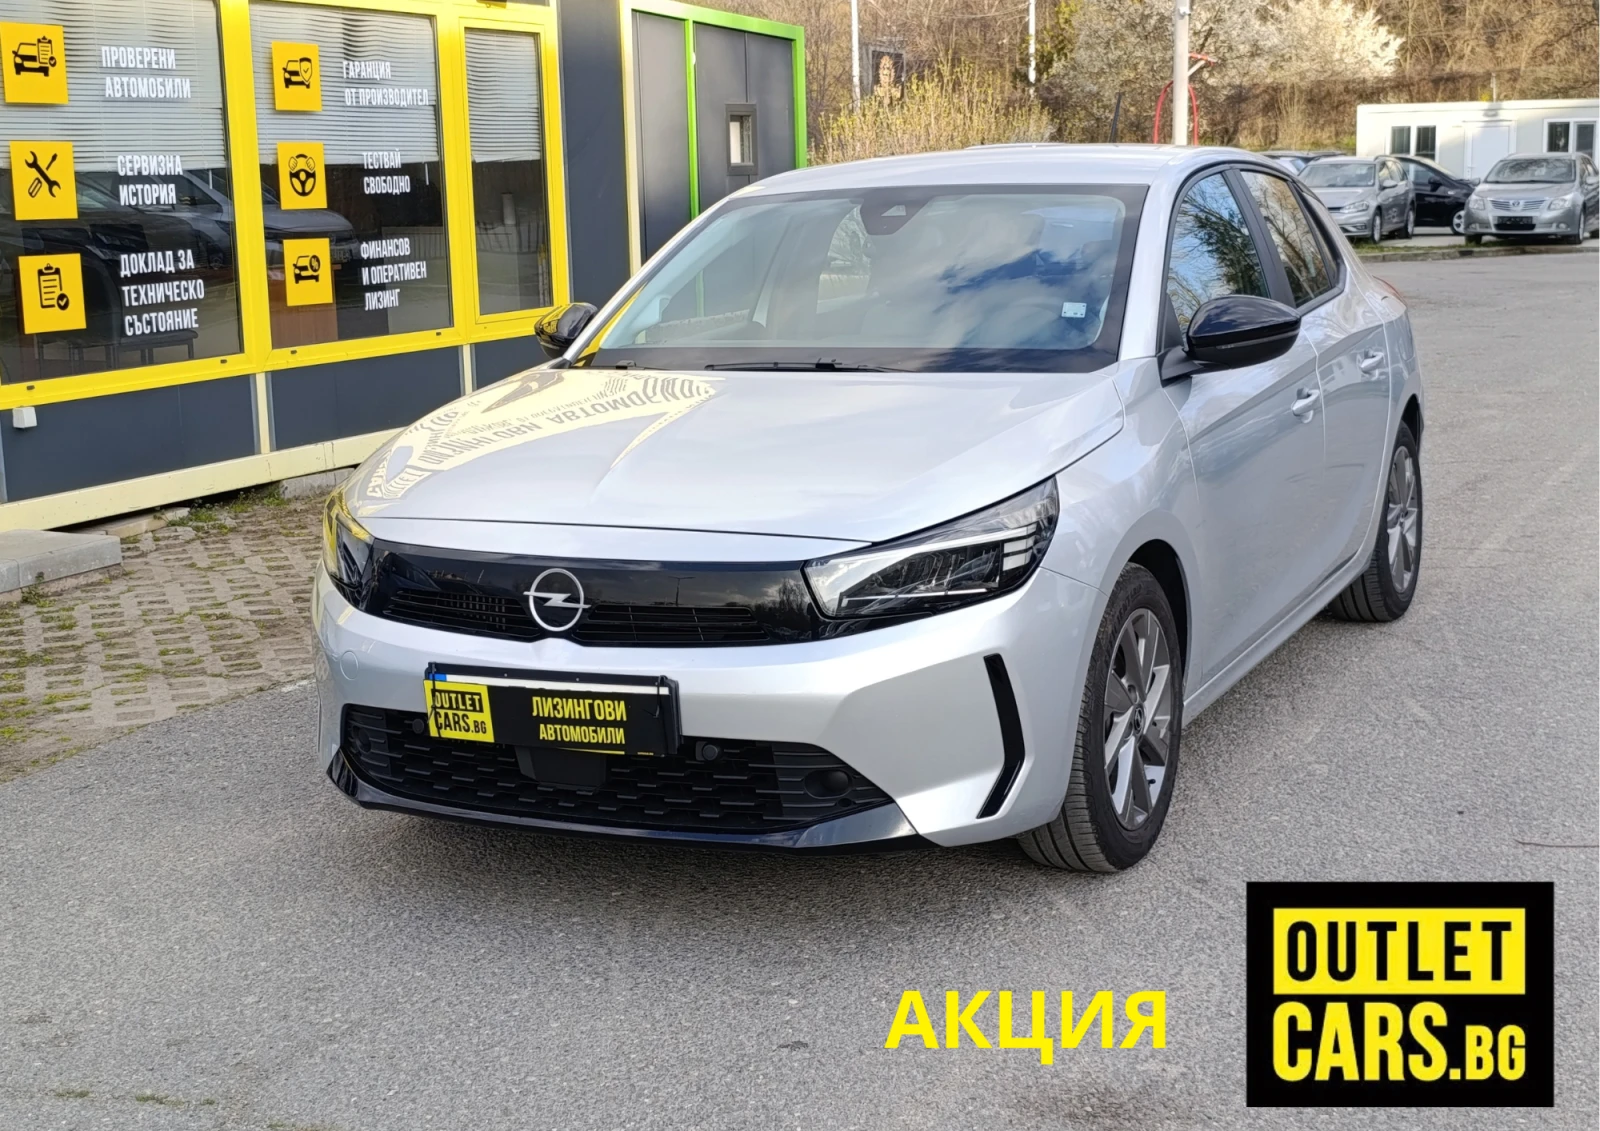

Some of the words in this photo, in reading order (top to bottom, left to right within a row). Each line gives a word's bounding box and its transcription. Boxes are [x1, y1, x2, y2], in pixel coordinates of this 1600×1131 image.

[101, 46, 176, 69] ПРОВЕРЕНИ
[342, 60, 392, 80] ГАРАНЦИЯ
[105, 76, 192, 99] АВТОМОБИЛИ
[344, 88, 357, 106] ОТ
[359, 88, 429, 107] ПРОИЗВОДИТЕЛ
[117, 154, 183, 176] СЕРВИЗНА
[362, 148, 402, 170] ТЕСТВАЙ
[119, 183, 177, 206] ИСТОРИЯ
[363, 175, 411, 195] СВОБОДНО
[360, 237, 411, 260] ФИНАНСОВ
[120, 250, 175, 278] ДОКЛАД
[178, 249, 195, 270] ЗА
[361, 267, 370, 286] И
[371, 260, 427, 285] ОПЕРАТИВЕН
[122, 278, 205, 307] ТЕХНИЧЕСКО
[364, 288, 401, 312] ЛИЗИНГ
[124, 307, 199, 337] СЪСТОЯНИЕ
[433, 691, 481, 712] OUTLET
[531, 696, 628, 722] ЛИЗИНГОВИ
[434, 711, 487, 735] CARS.BG
[539, 723, 626, 745] АВТОМОБИЛИ
